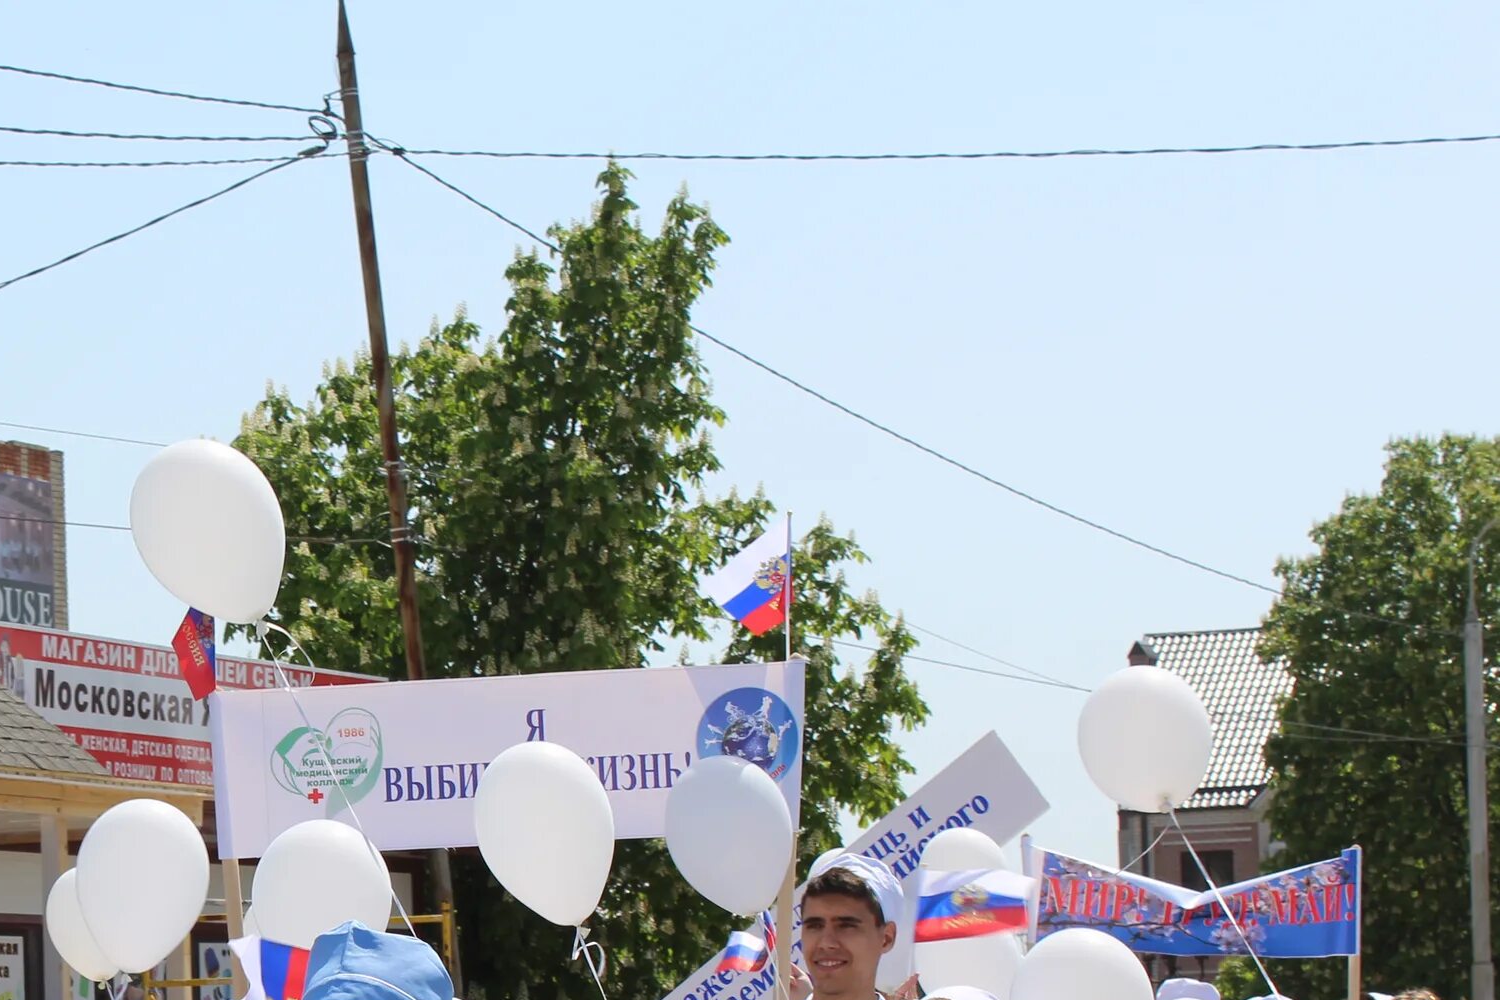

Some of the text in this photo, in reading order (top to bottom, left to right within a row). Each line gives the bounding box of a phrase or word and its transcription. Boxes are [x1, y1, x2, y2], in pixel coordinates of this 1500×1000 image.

[41, 635, 136, 670] МАГАЗИН
[141, 650, 180, 677] ДЛЯ
[35, 667, 194, 726] Московская
[337, 727, 366, 738] 1986
[526, 708, 547, 742] Я
[160, 766, 174, 782] ПО
[383, 761, 490, 803] ВЫБИ
[1045, 876, 1145, 922] МИР!
[1268, 874, 1357, 926] МАЙ!
